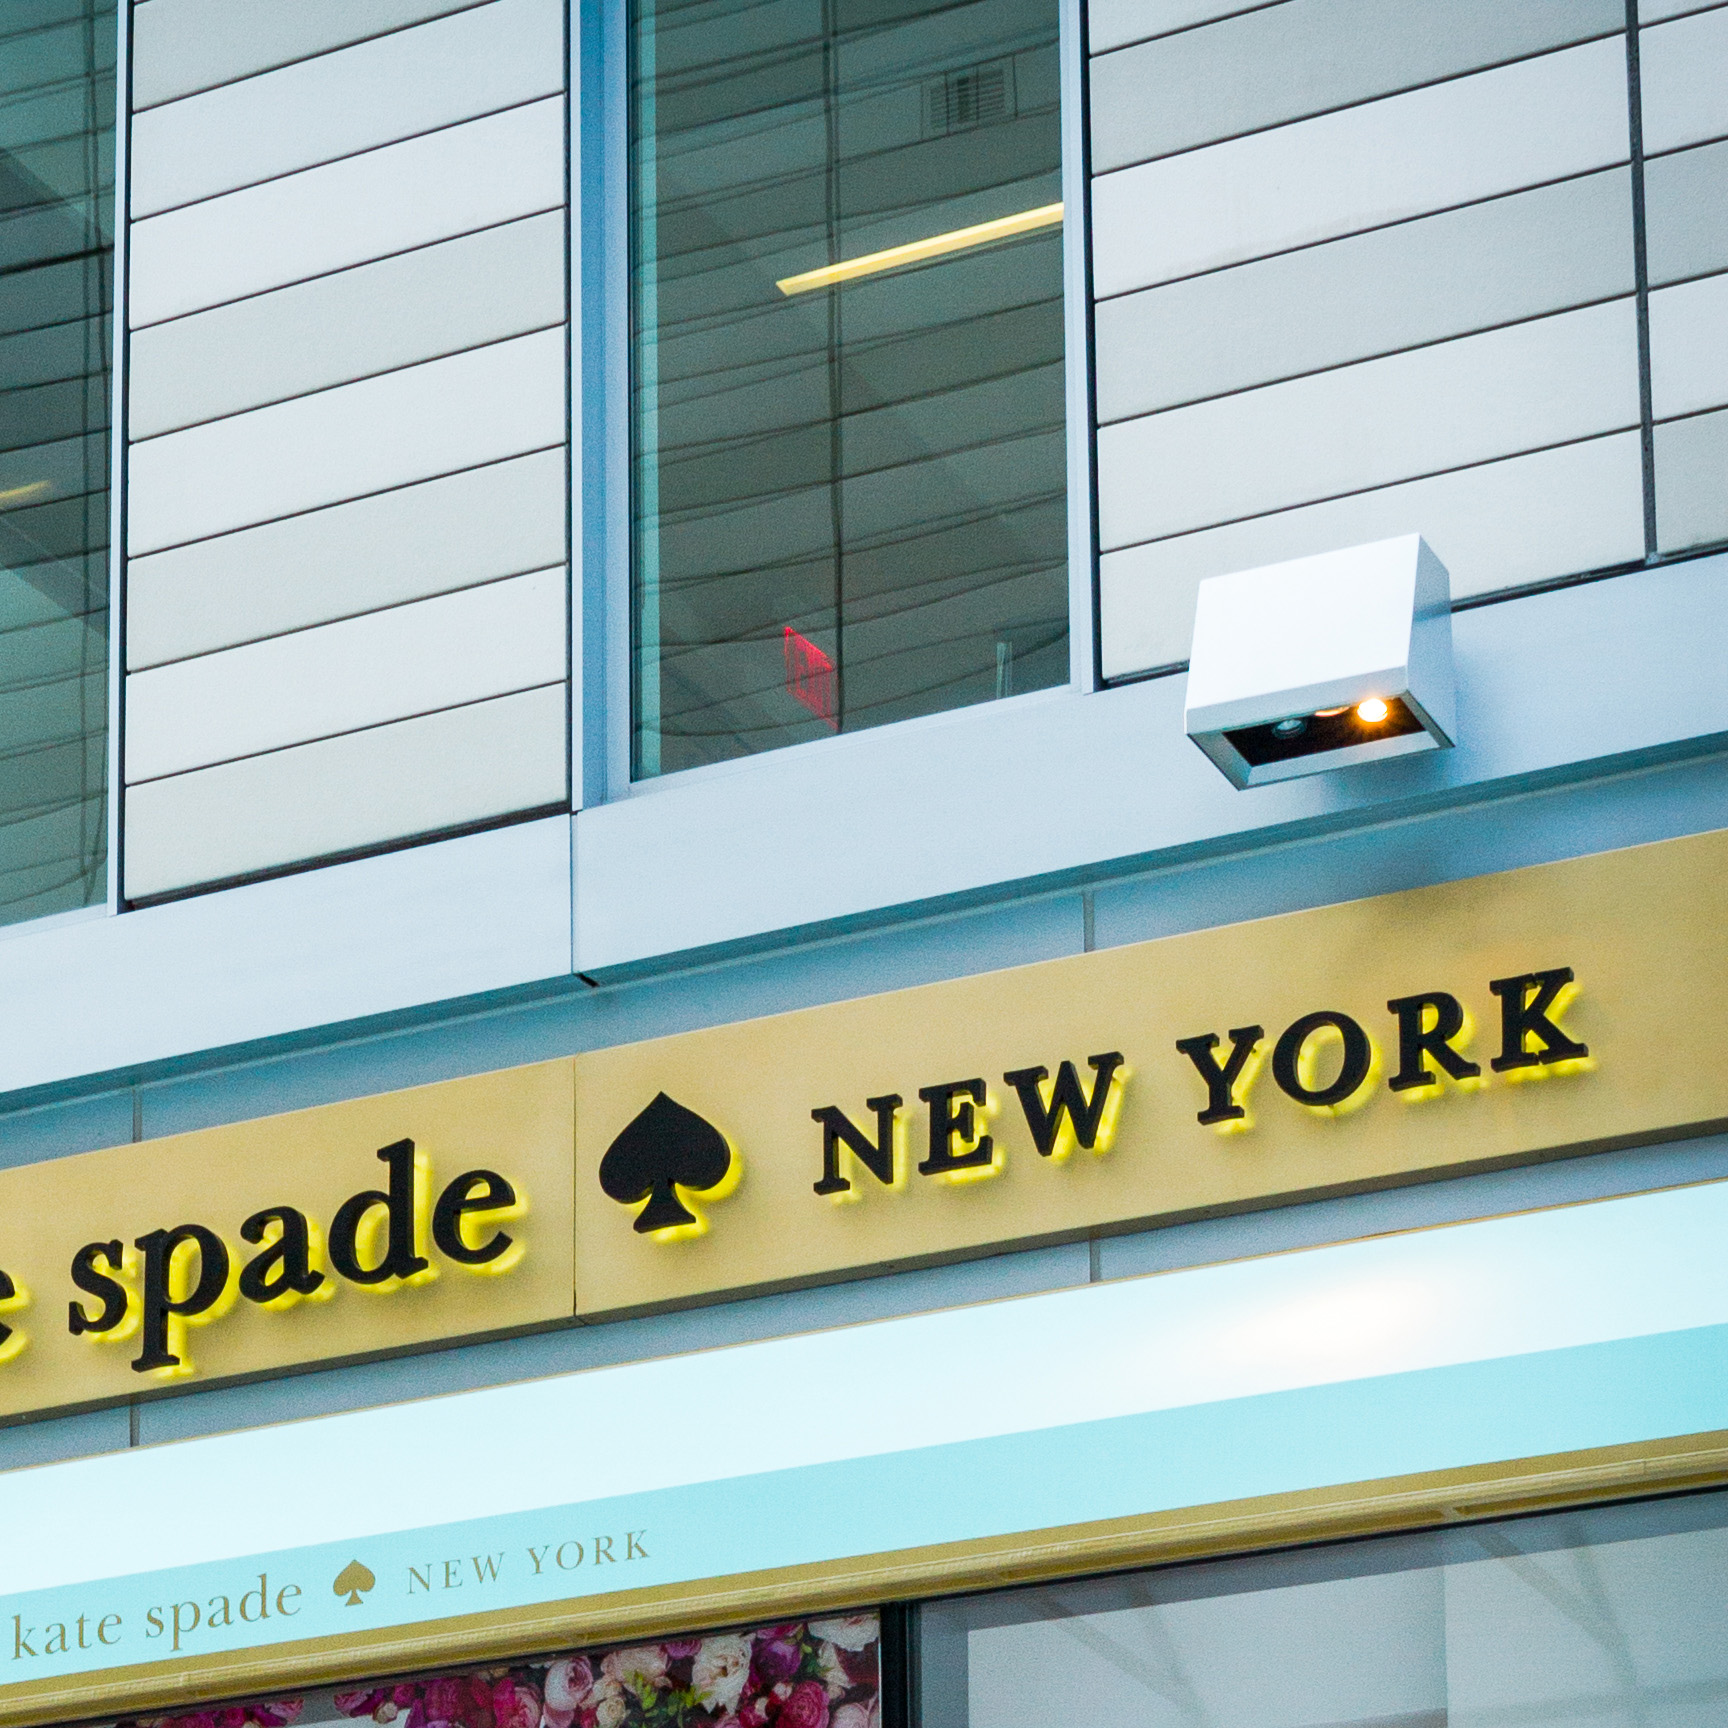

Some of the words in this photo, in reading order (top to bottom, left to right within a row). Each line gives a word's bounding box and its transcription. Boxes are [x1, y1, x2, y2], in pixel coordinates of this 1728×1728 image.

[68, 1138, 516, 1374] spade
[811, 1051, 1125, 1196] NEW
[1176, 967, 1589, 1126] YORK
[11, 1612, 122, 1660] kate
[145, 1573, 302, 1652] spade
[407, 1552, 505, 1595] NEW
[526, 1529, 651, 1576] YORK
